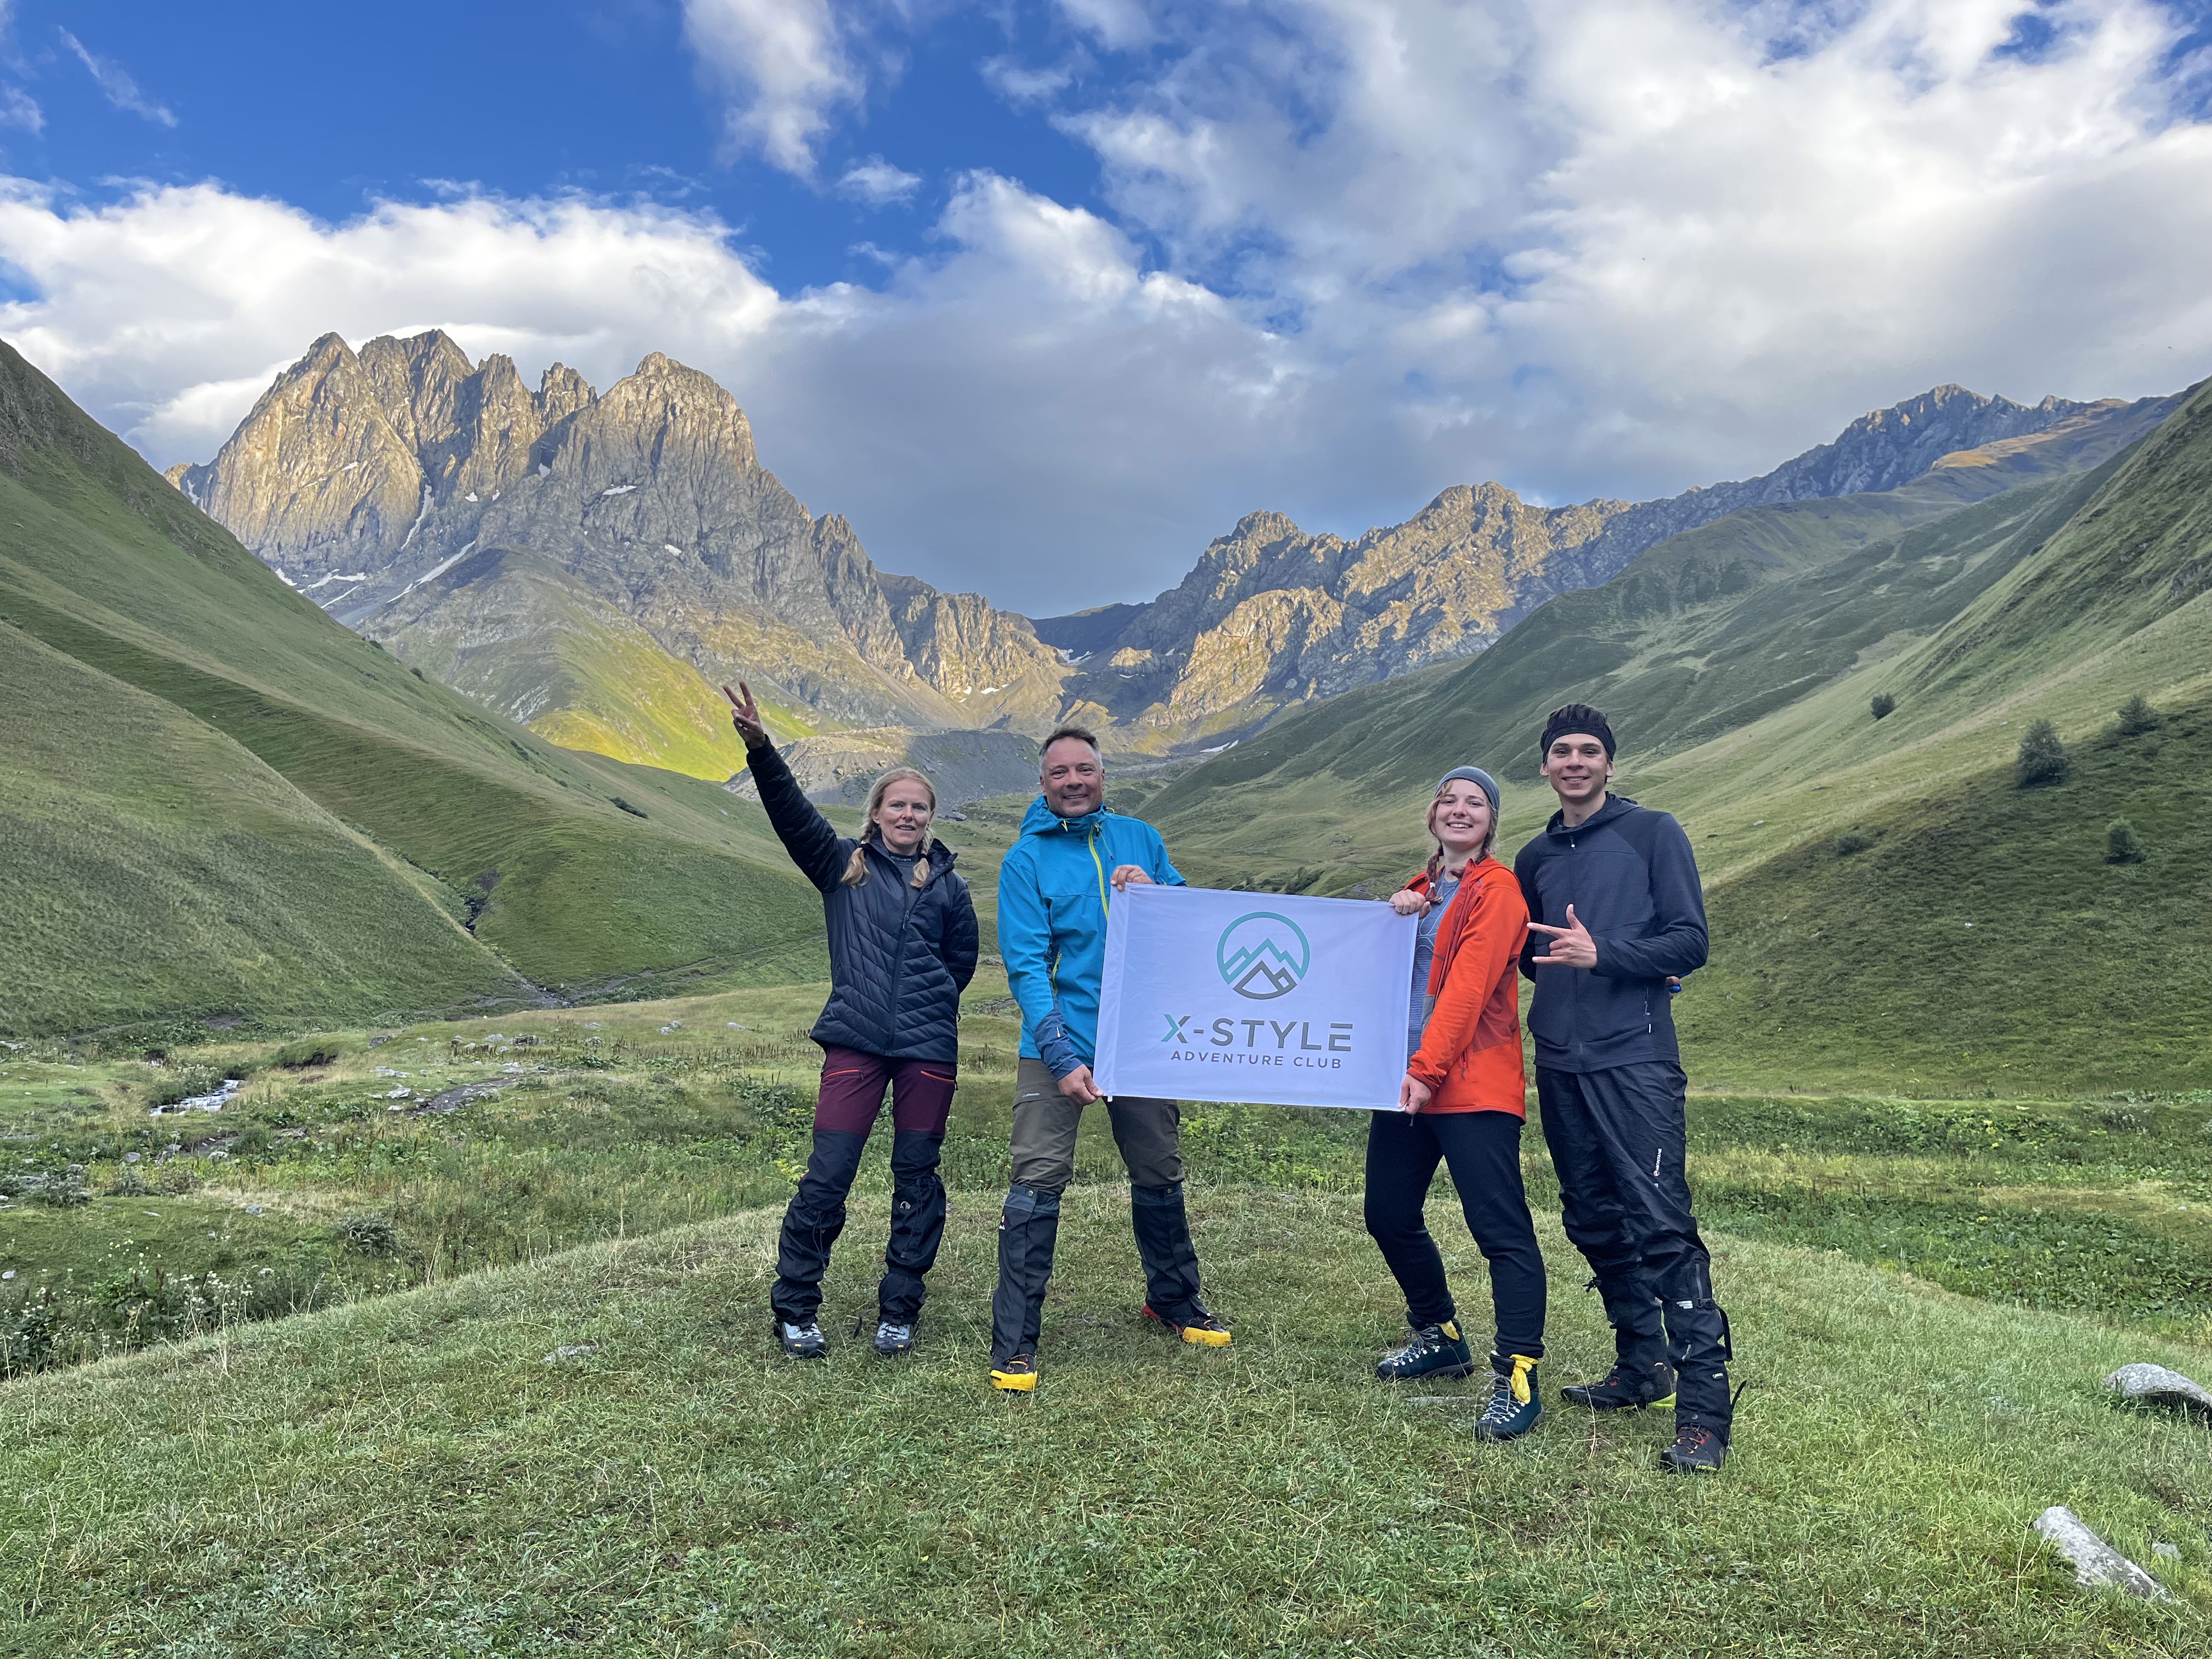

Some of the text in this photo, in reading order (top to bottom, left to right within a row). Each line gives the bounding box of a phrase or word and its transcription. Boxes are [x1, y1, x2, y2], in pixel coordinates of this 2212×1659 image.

[1161, 1014, 1353, 1052] X-STYLE
[1171, 1050, 1341, 1069] ADVENTURE CLUB
